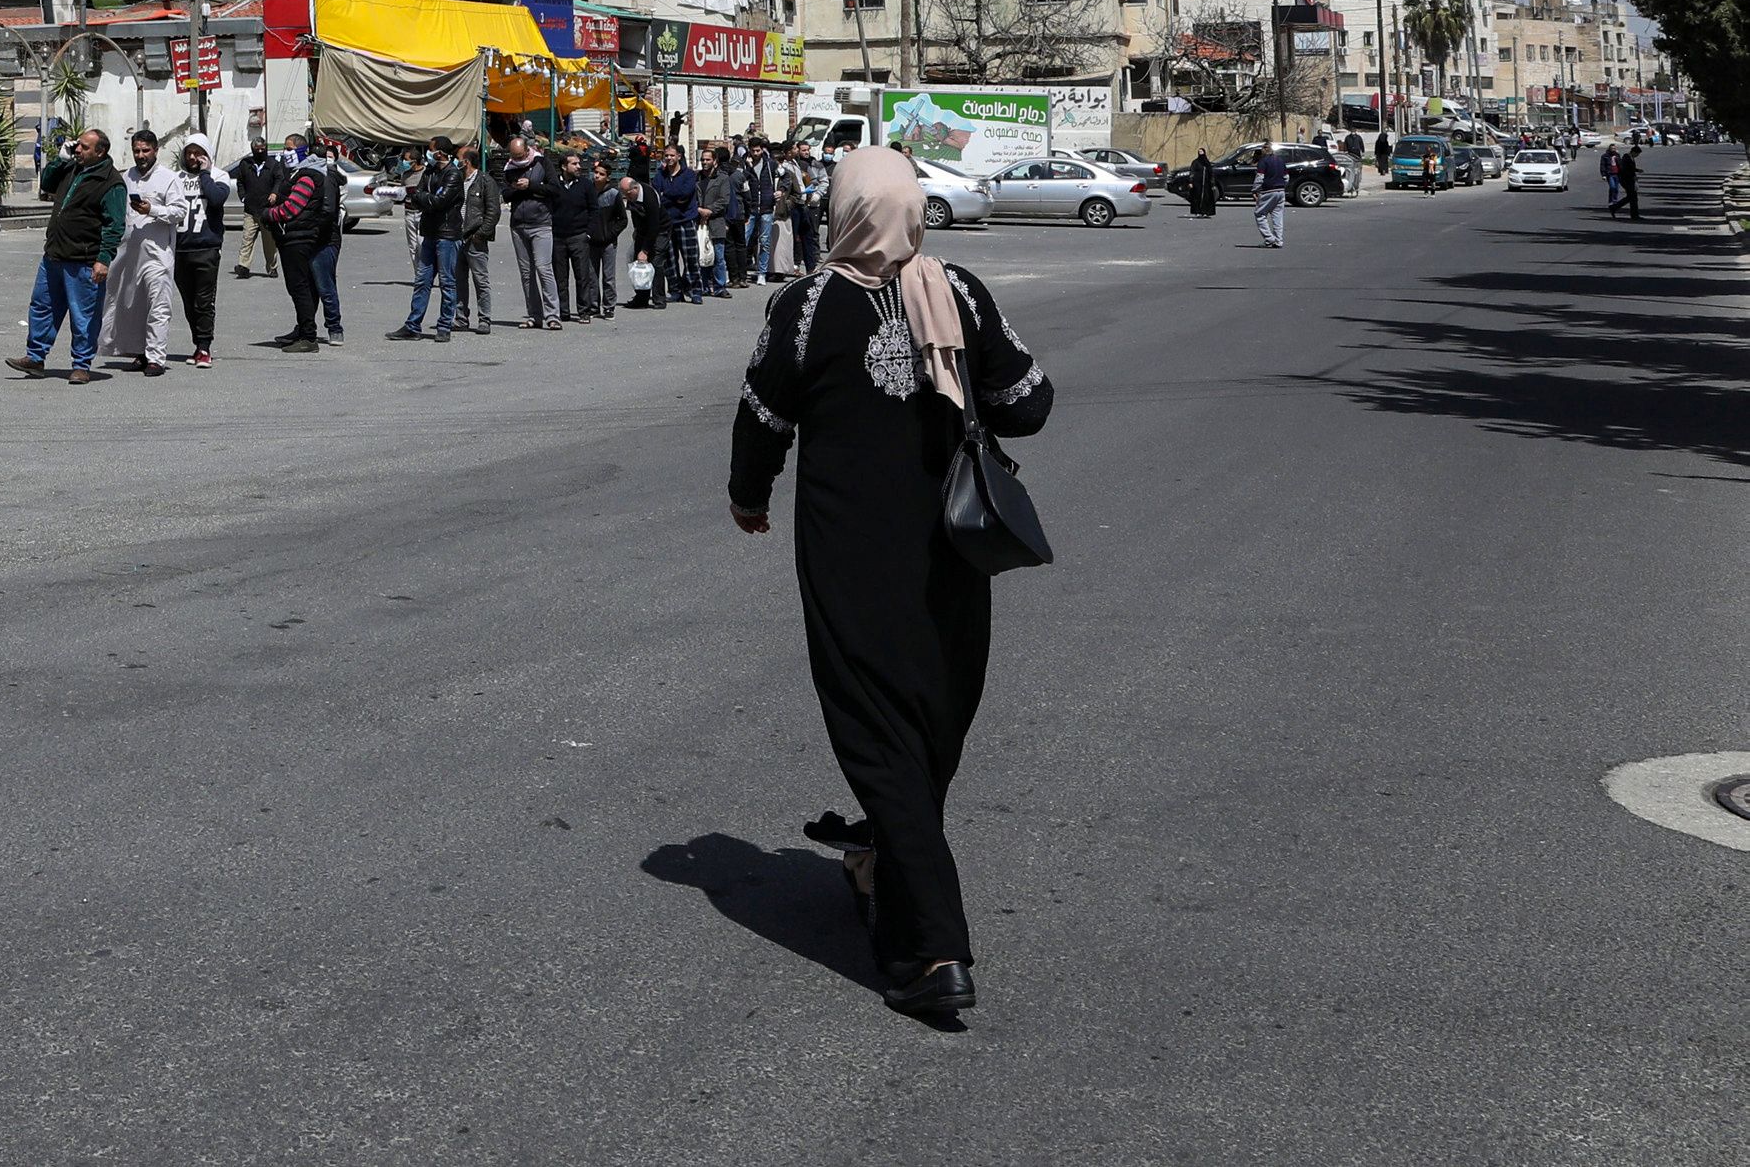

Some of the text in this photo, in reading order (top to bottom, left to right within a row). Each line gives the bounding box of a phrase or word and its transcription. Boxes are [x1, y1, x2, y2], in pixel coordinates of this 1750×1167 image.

[693, 32, 757, 73] البان الندى
[1067, 87, 1108, 109] بوابة
[962, 99, 1017, 120] الطاحونة
[1017, 104, 1047, 124] دجاج
